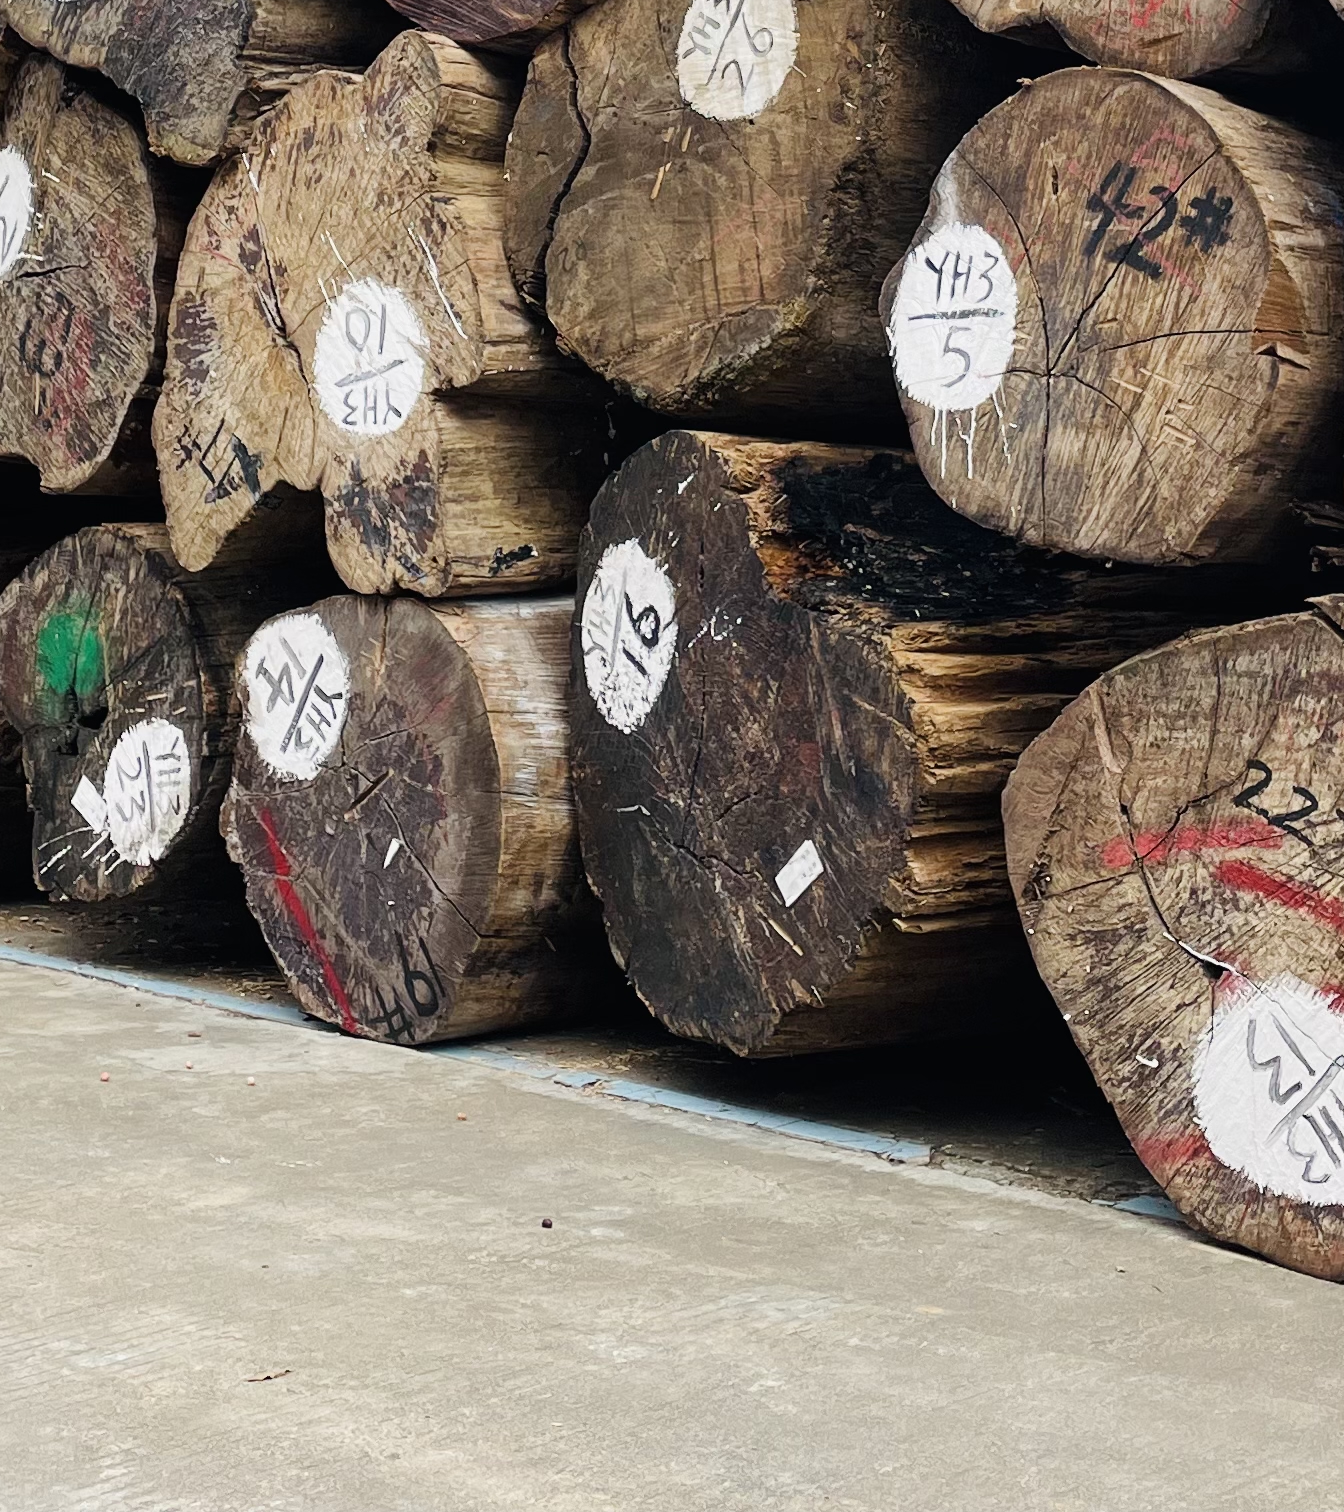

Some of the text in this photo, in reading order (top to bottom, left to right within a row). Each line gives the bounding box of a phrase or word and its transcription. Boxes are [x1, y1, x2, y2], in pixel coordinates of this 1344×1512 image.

[721, 10, 774, 96] 26
[924, 250, 1001, 305] YH3
[344, 303, 387, 355] 10
[941, 324, 972, 388] 5
[341, 388, 404, 428] YH3
[621, 591, 662, 677] 16
[255, 636, 309, 714] 14
[292, 683, 344, 762] YH3
[155, 735, 183, 818] YH3
[1247, 1012, 1318, 1105] 13
